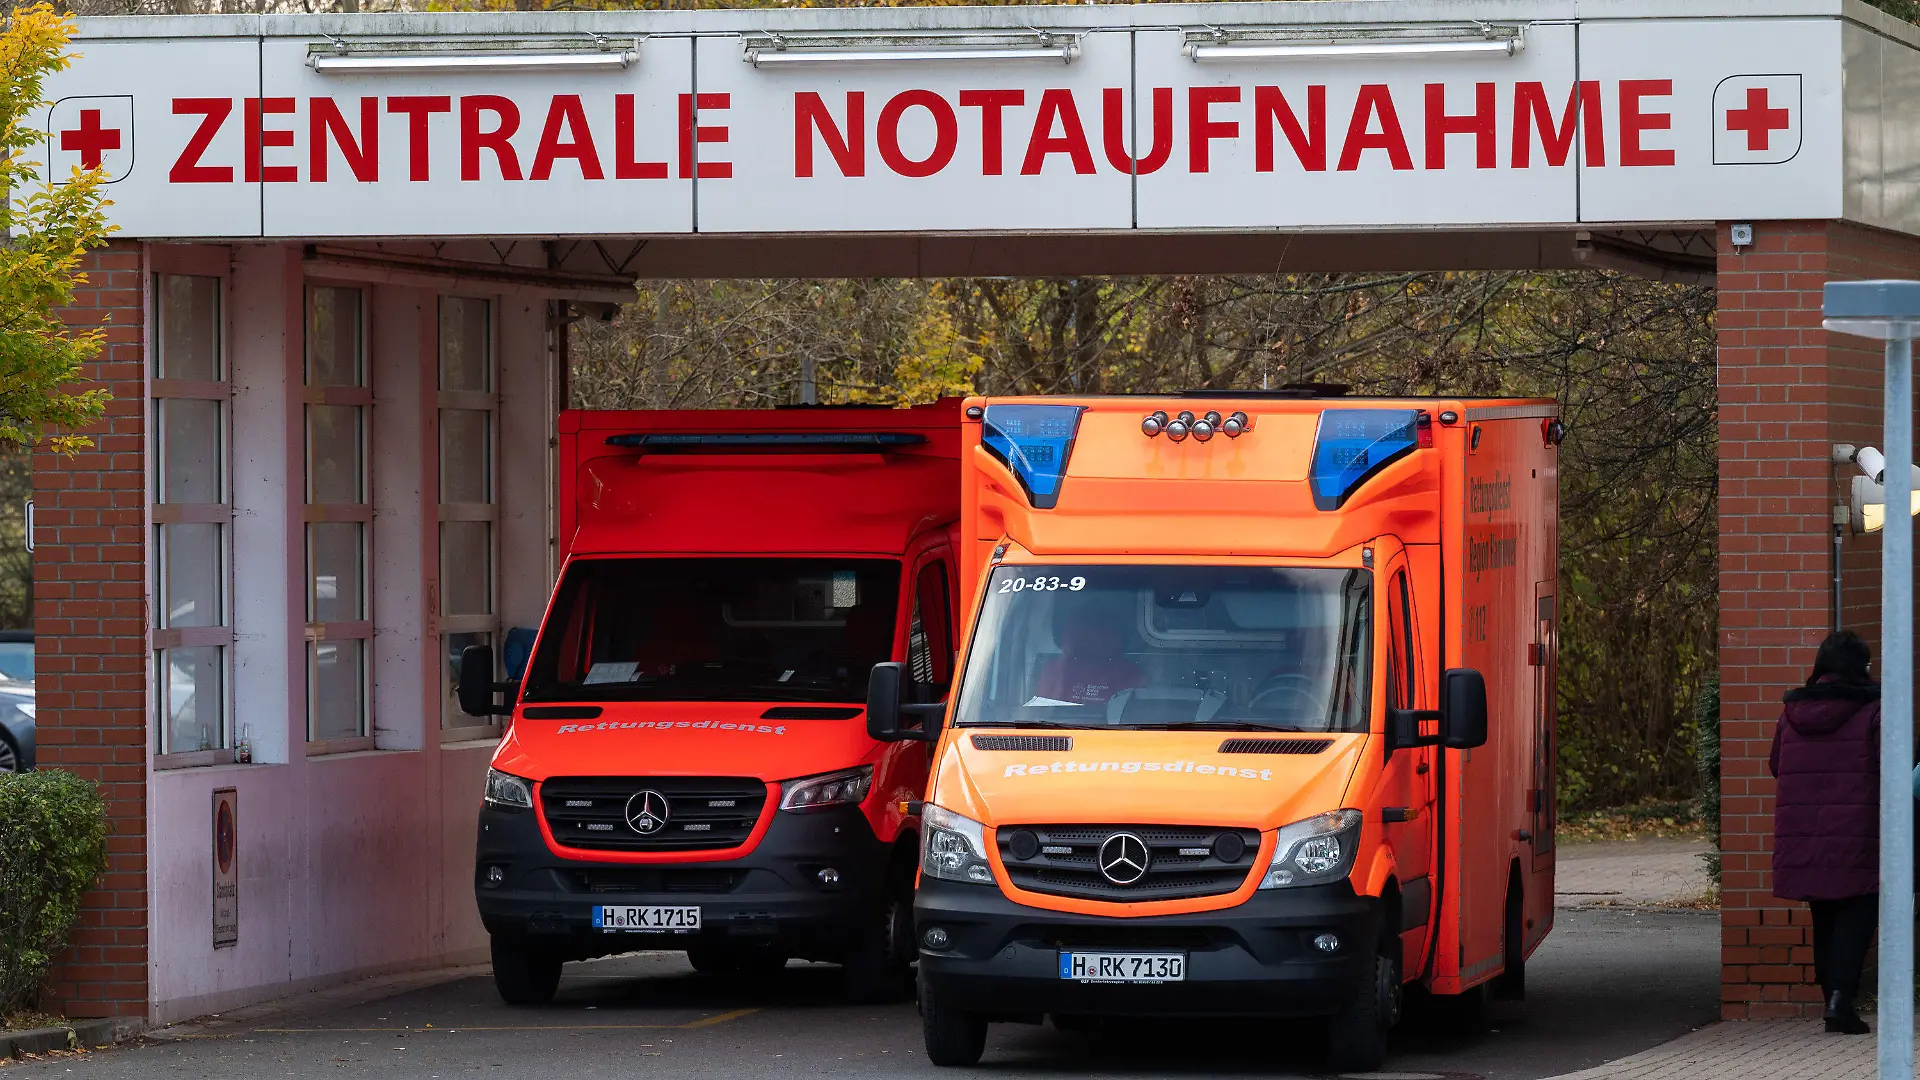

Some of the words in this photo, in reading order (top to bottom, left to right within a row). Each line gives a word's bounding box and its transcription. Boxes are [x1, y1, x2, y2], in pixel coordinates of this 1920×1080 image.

[169, 93, 733, 184] ZENTRALE
[794, 79, 1675, 178] NOTAUFNAHME
[1470, 469, 1511, 523] Rettungsdienst
[1469, 532, 1489, 583] Region
[1490, 532, 1517, 570] Hannover
[997, 576, 1086, 594] 20-83-9
[1475, 604, 1487, 643] 112
[557, 720, 787, 735] Rettungsdienst
[1003, 760, 1273, 781] Rettungsdienst
[603, 908, 615, 926] H
[626, 908, 649, 926] RK
[653, 908, 698, 927] 1715
[1073, 956, 1086, 976] H
[1099, 957, 1125, 977] RK
[1130, 957, 1181, 978] 7130
